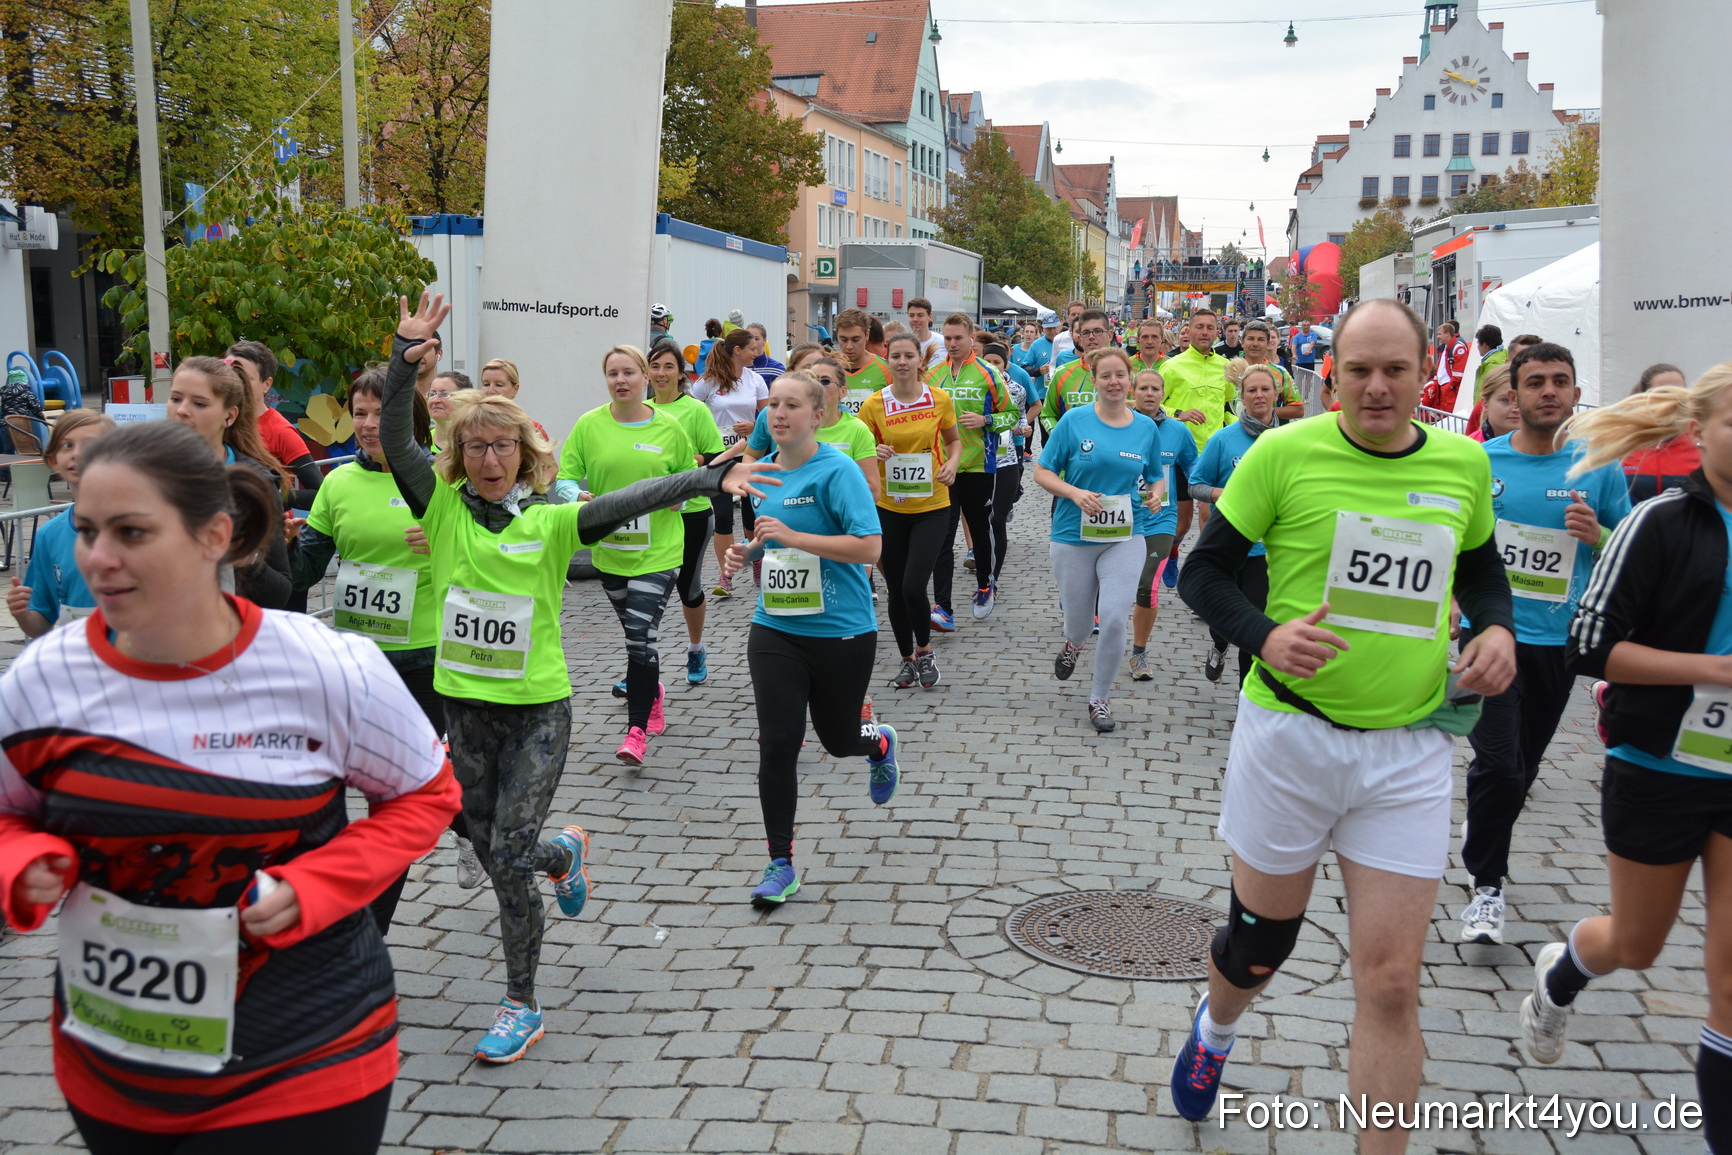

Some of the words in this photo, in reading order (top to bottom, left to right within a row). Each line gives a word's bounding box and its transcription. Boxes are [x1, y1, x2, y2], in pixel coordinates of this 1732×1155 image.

[820, 260, 833, 274] D
[1187, 283, 1205, 291] ZIEL
[482, 299, 619, 318] www.bmw-laufsport.de
[885, 417, 908, 427] MAX
[911, 411, 937, 421] BÖGL
[892, 466, 926, 480] 5172
[783, 495, 816, 506] BOCK
[1089, 509, 1126, 525] 5014
[1383, 528, 1422, 542] BOCK
[1503, 543, 1562, 573] 5192
[1347, 549, 1433, 593] 5210
[768, 569, 810, 590] 5037
[1511, 574, 1544, 588] Maisam
[344, 584, 402, 615] 5143
[476, 598, 506, 609] BOCK
[771, 595, 810, 606] Anna-Carina
[348, 616, 391, 630] Anja-Marie
[454, 613, 517, 646] 5106
[470, 649, 493, 662] Petra
[194, 733, 303, 750] NEUMARKT
[116, 917, 179, 937] BOCK
[83, 940, 207, 1005] 5220
[72, 993, 203, 1047] Annemarie
